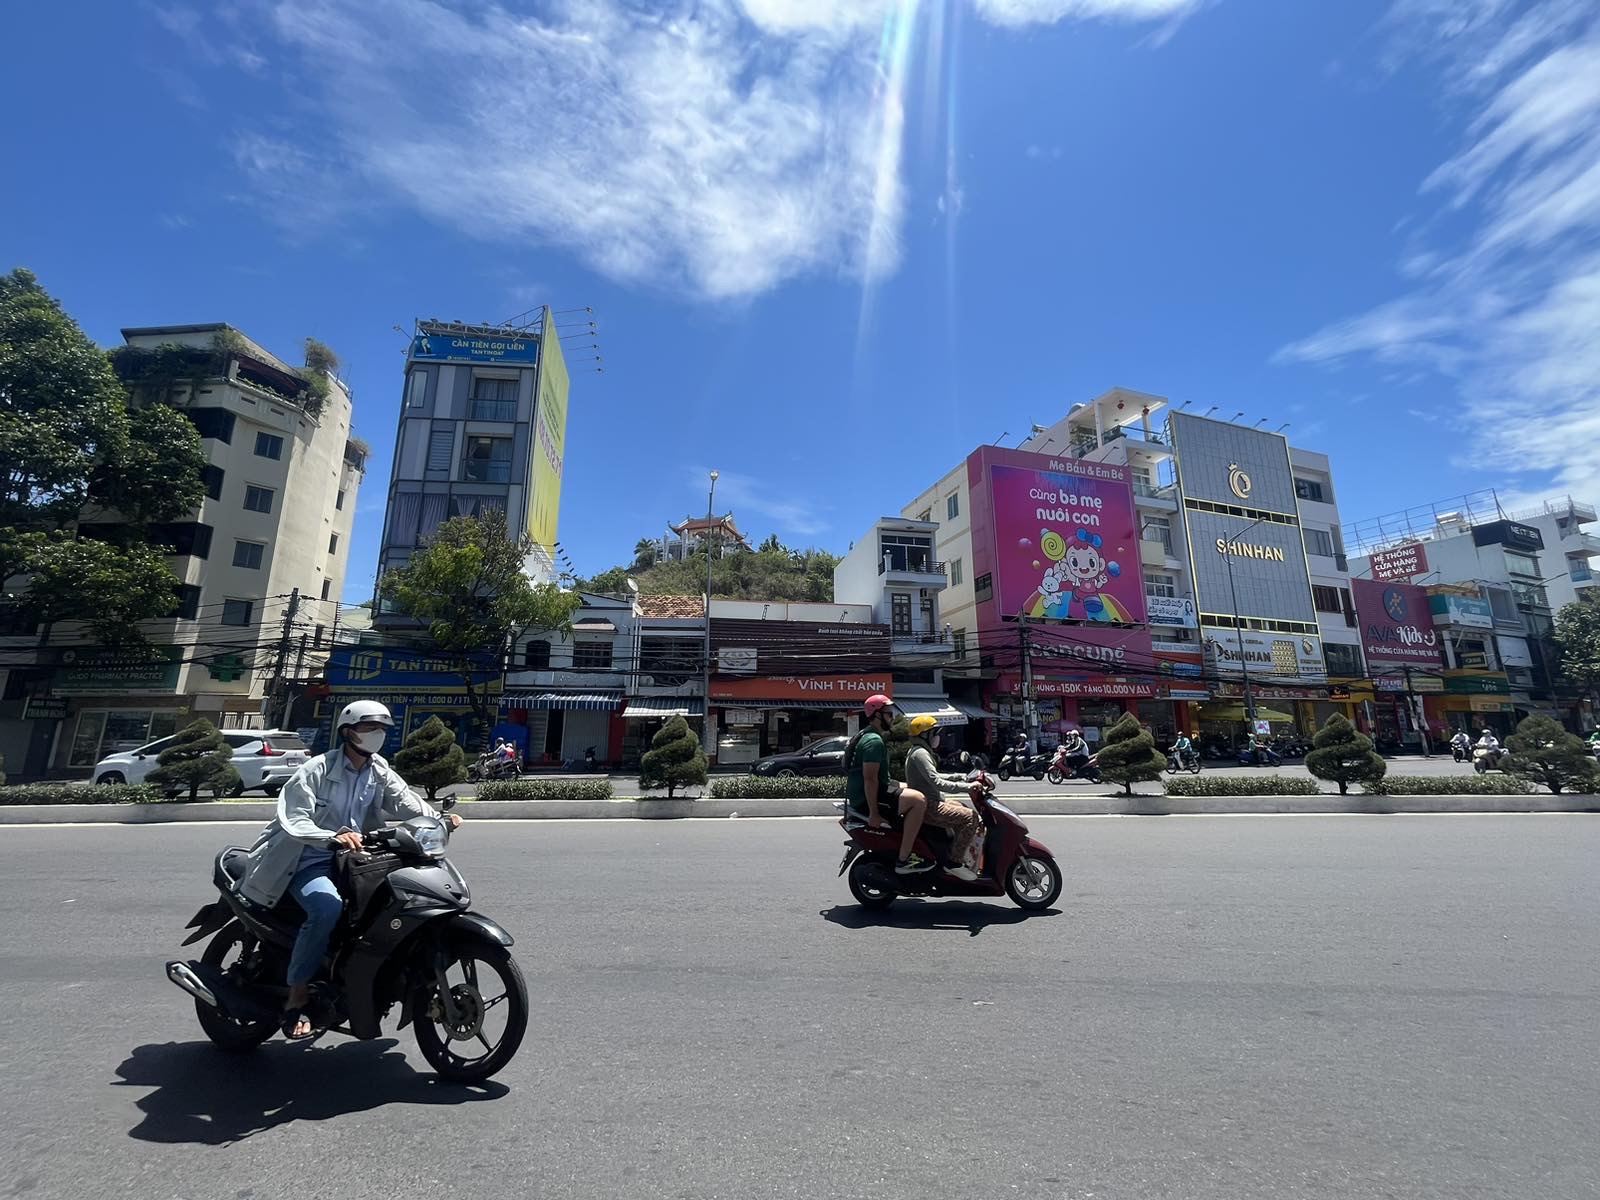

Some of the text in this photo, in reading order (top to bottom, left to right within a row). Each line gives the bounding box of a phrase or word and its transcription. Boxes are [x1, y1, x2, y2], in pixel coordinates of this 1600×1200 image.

[1087, 465, 1095, 475] &
[1095, 466, 1110, 479] Em
[1111, 468, 1124, 480] Bé
[1029, 487, 1103, 512] Cùng ba mẹ
[1036, 507, 1100, 526] nuôi con
[1216, 537, 1284, 562] SHINHAN
[1393, 556, 1418, 568] HÀNG
[1223, 649, 1271, 663] SHINHAN
[129, 672, 163, 681] PRACTICE
[798, 678, 833, 690] VĨNH
[837, 678, 886, 690] THÀNH
[1103, 684, 1128, 695] 10.000
[1128, 685, 1151, 695] VALI
